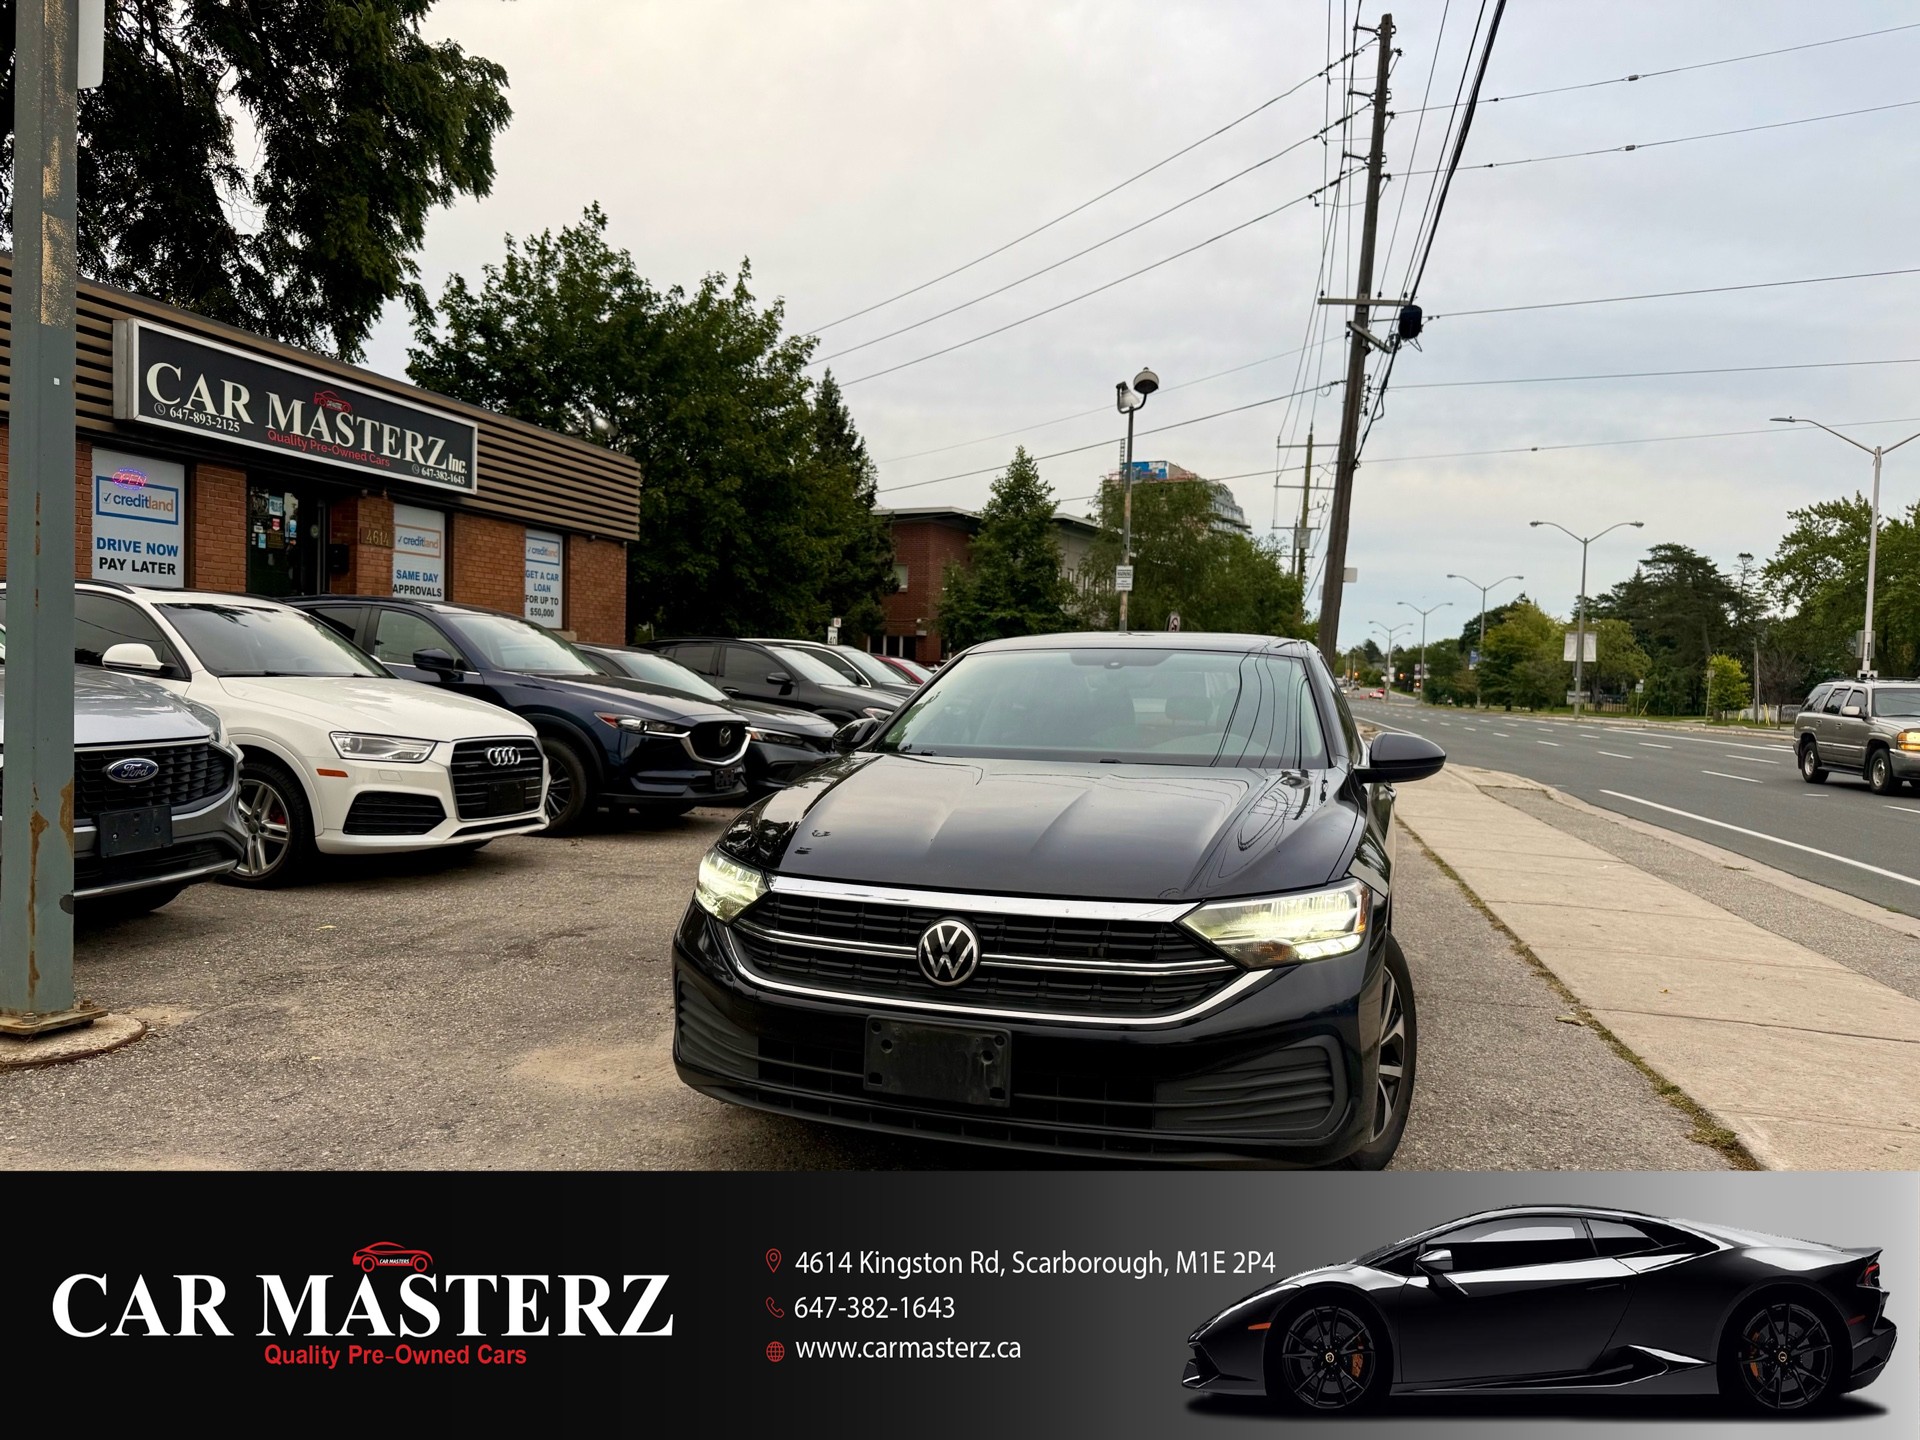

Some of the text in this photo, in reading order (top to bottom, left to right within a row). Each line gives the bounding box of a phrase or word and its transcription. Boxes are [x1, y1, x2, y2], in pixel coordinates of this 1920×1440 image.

[146, 362, 467, 474] CAR MASTERZ Inc.
[169, 406, 240, 433] 647-893-2125
[267, 430, 391, 467] Quality Pre-Owned Cars
[112, 471, 147, 487] OPEN
[421, 466, 466, 485] 647-382-1643
[113, 493, 174, 513] creditland
[366, 530, 389, 546] 4614
[403, 536, 439, 549] creditland
[96, 537, 179, 557] DRIVE NOW
[99, 557, 176, 576] PAY LATER
[396, 570, 439, 583] SAME DAY
[526, 570, 560, 582] GET A CAR
[393, 584, 442, 598] APPROVALS
[533, 584, 551, 593] LOAN
[526, 595, 559, 606] FOR UP TO
[530, 608, 555, 619] $50,000
[120, 763, 149, 778] Ford
